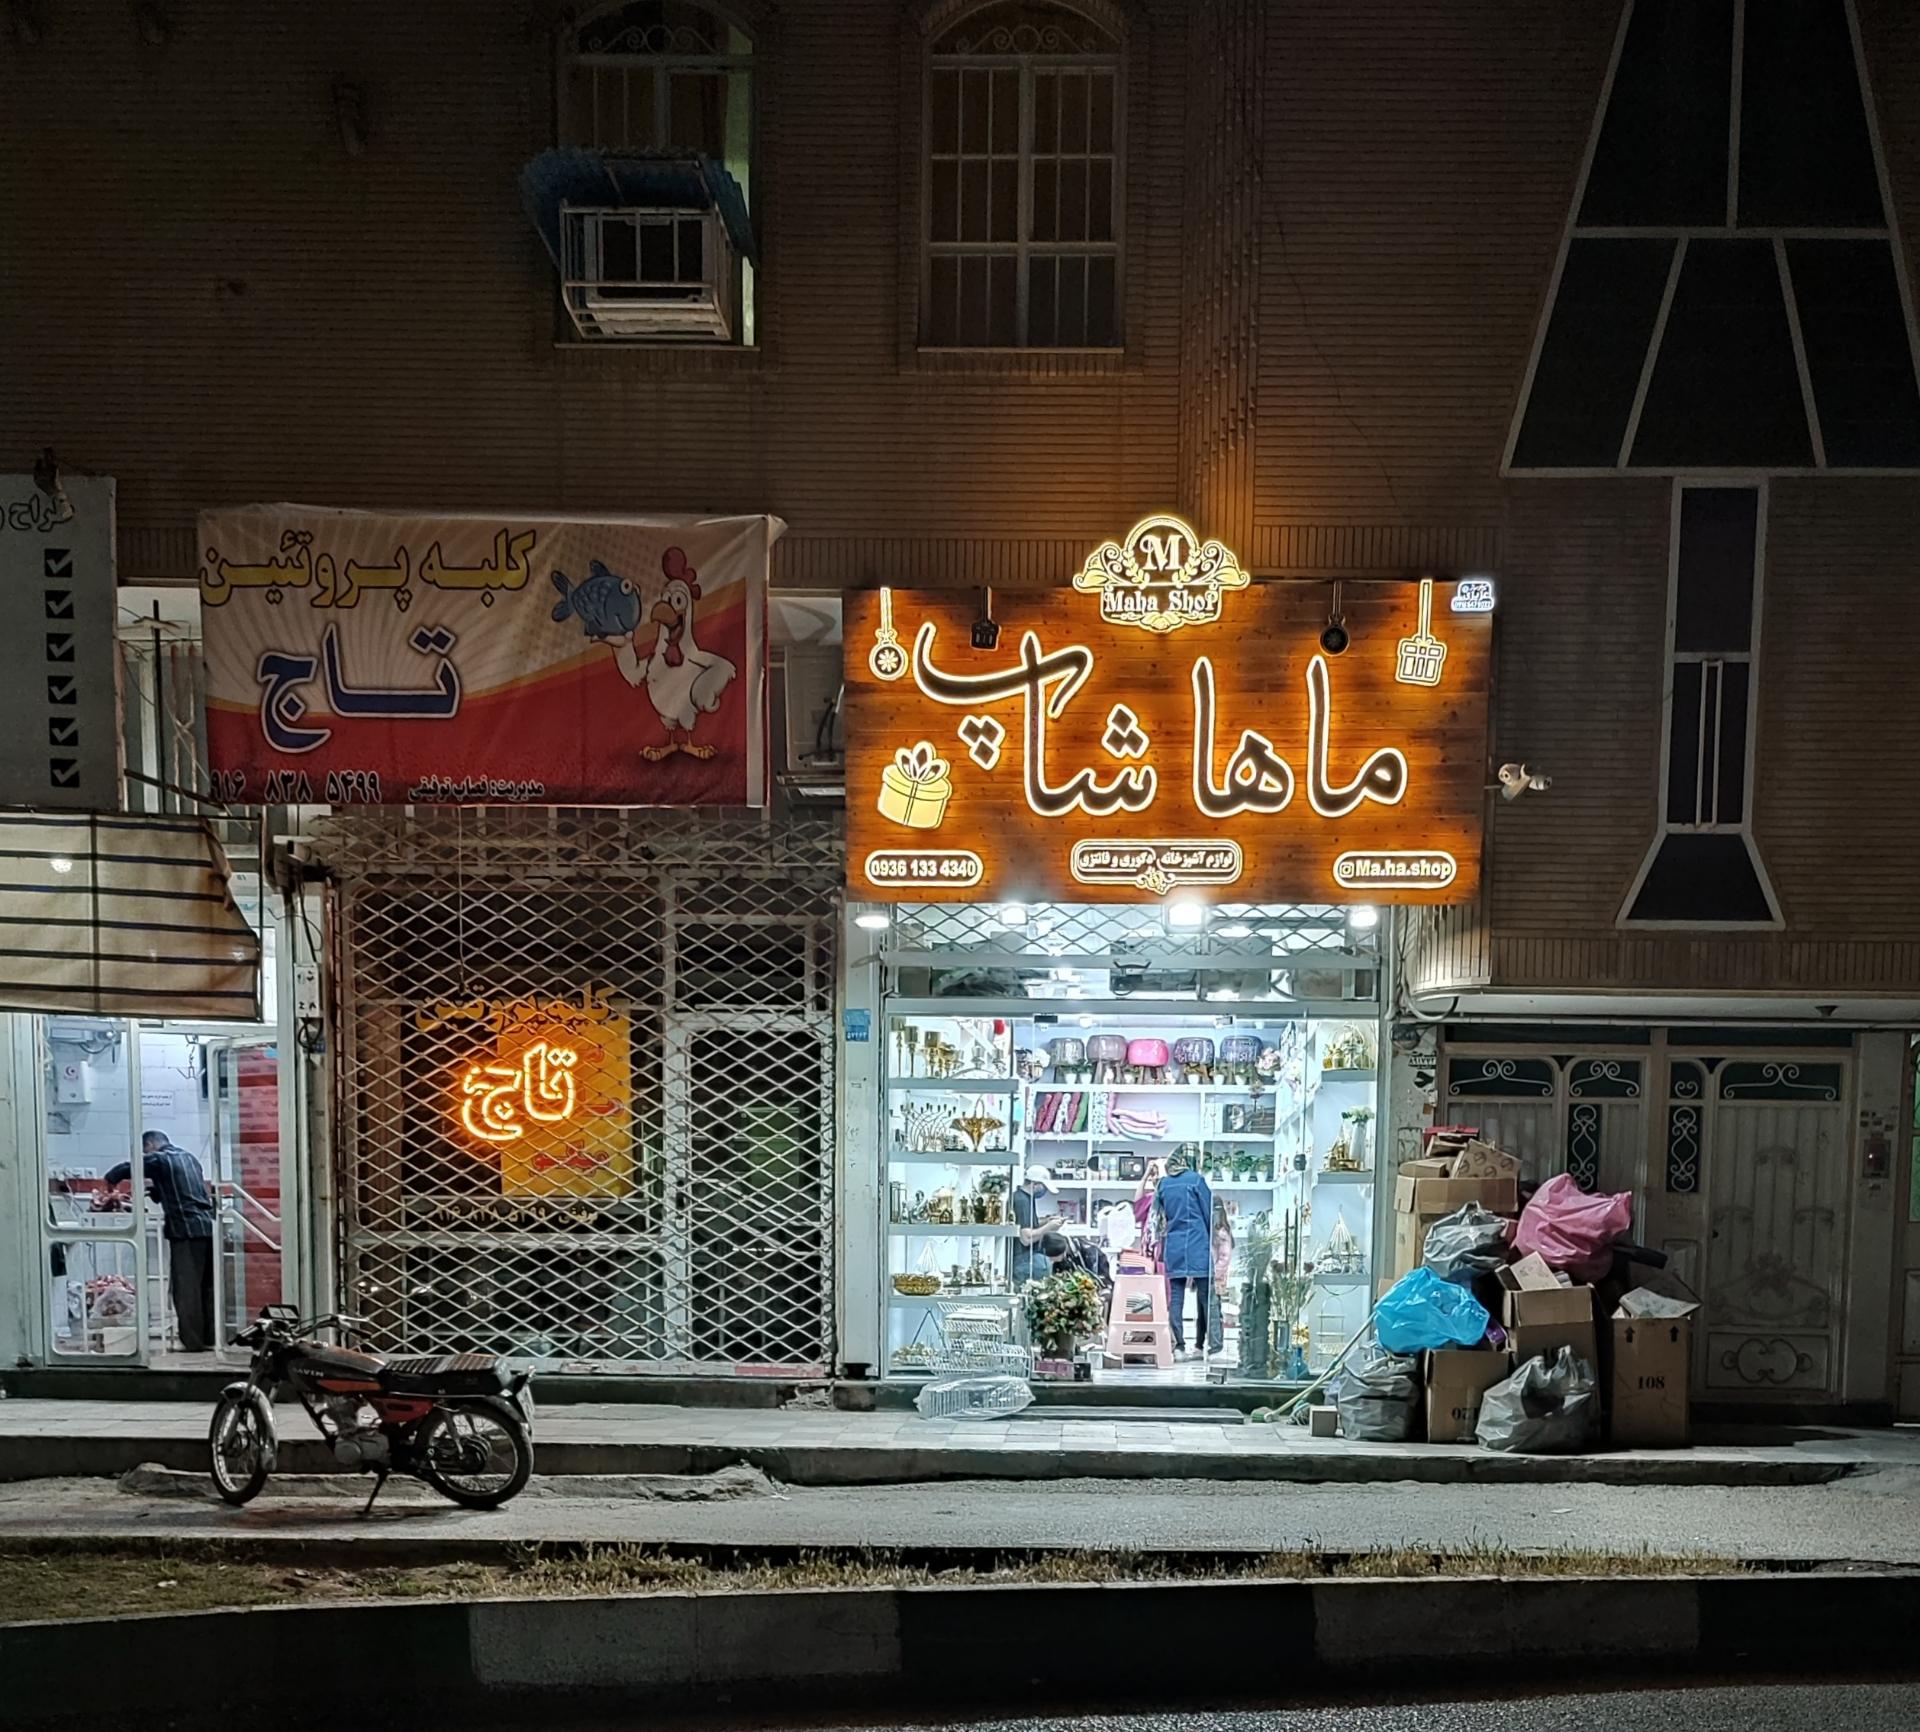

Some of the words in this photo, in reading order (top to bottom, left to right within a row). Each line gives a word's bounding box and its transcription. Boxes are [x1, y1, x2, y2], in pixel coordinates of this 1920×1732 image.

[200, 529, 413, 612] پروتئین
[419, 527, 537, 609] کلبه
[1139, 534, 1184, 572] M
[1104, 589, 1159, 615] Maha
[257, 622, 461, 754] تاج
[912, 622, 1158, 817] شاپ
[1191, 655, 1408, 818] ماها
[264, 769, 313, 803] ۸۳۸
[325, 769, 382, 804] ۵۴۹۹
[871, 859, 907, 877] 0936
[910, 859, 937, 877] 133
[939, 859, 977, 877] 4340
[1110, 855, 1119, 868] و
[1160, 850, 1206, 868] آشپزخانه
[1206, 851, 1233, 868] لوازم
[462, 1043, 578, 1141] تاج
[1637, 1375, 1666, 1390] 108
